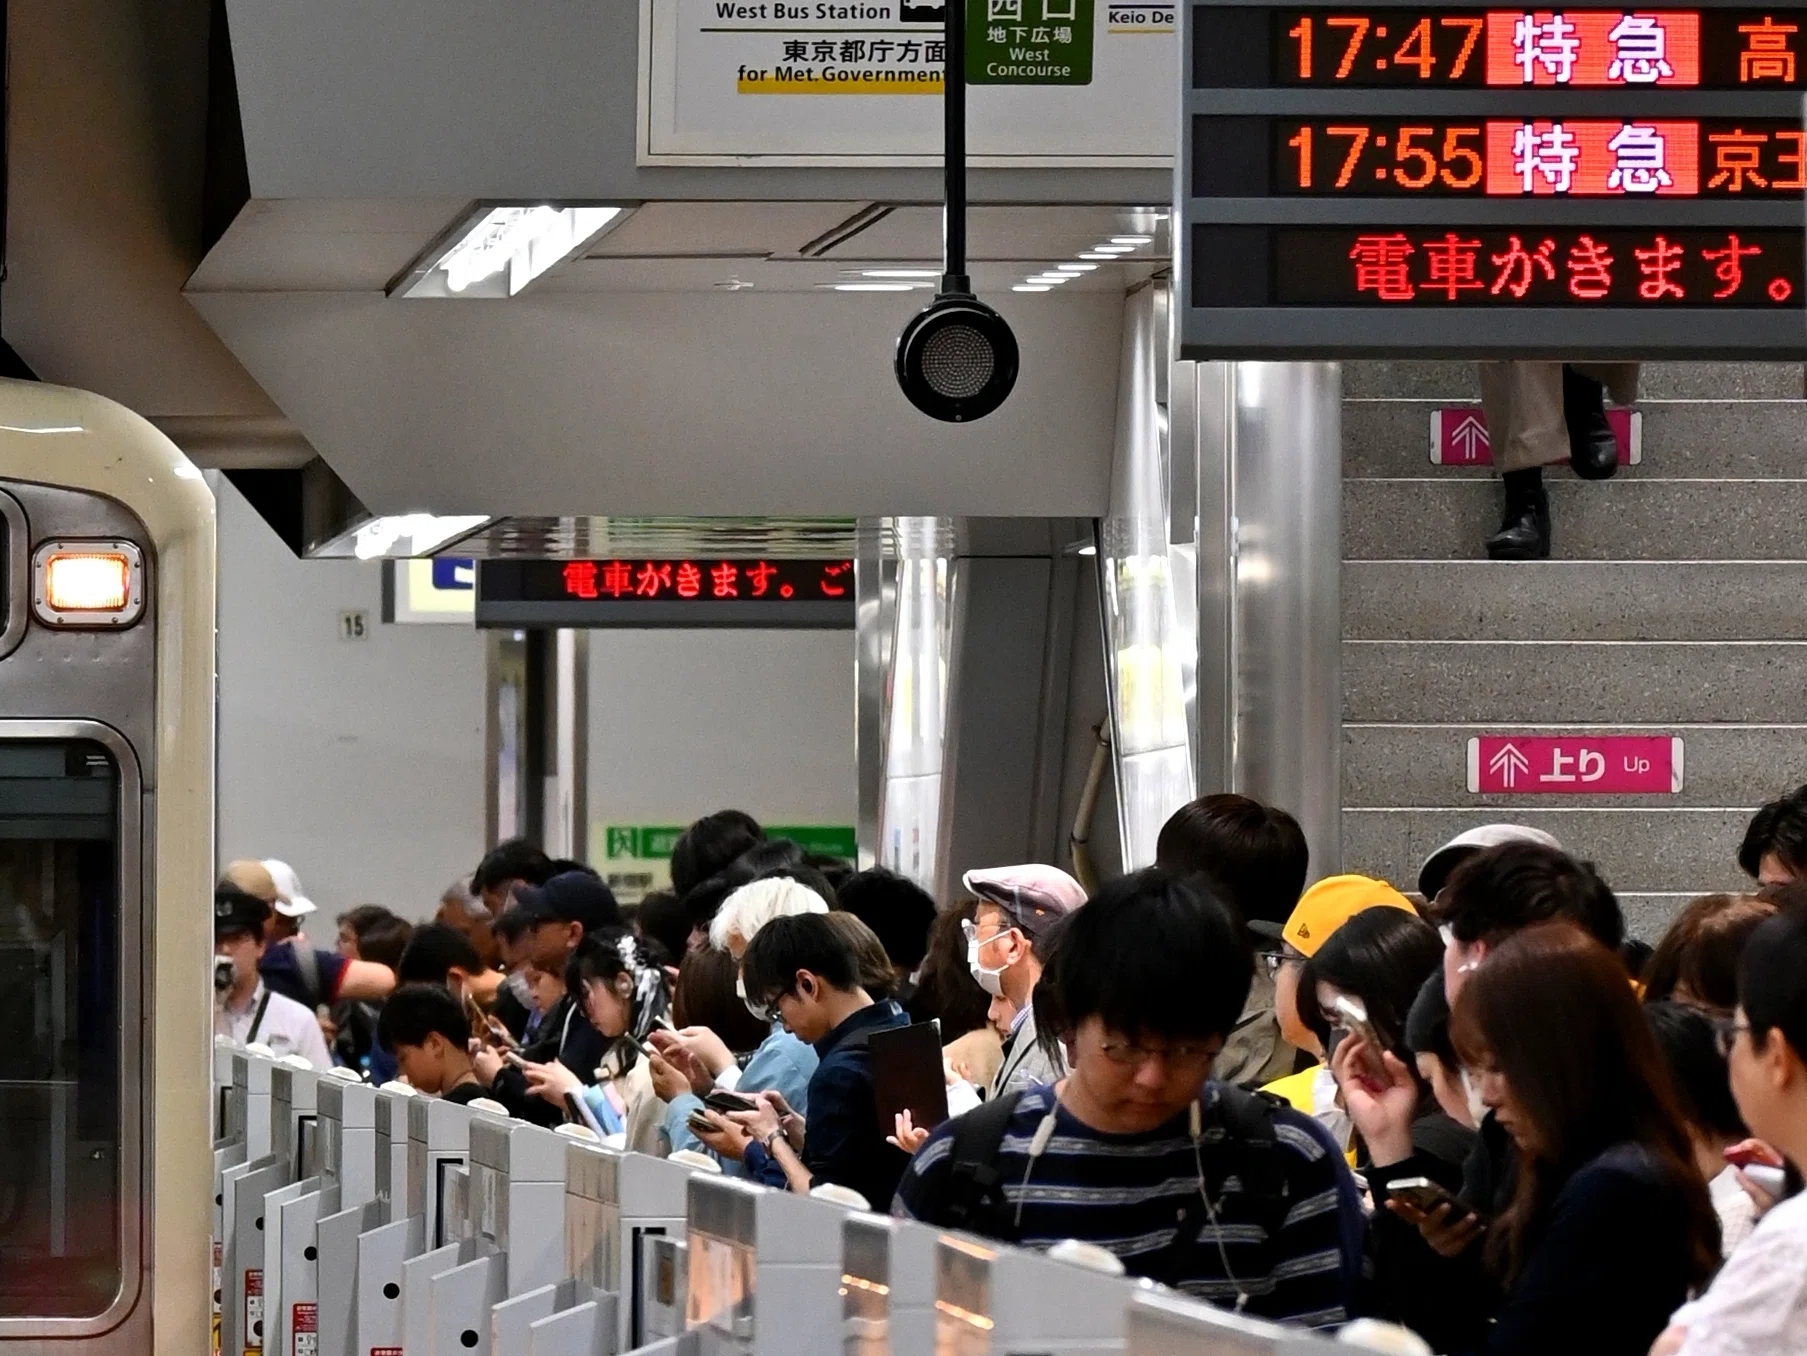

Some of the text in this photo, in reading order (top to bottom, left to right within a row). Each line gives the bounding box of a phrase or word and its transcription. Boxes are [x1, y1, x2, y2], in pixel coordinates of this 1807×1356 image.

[716, 3, 891, 19] West Bus Station
[1108, 11, 1146, 24] Keio
[987, 27, 1072, 43] 地下広場
[782, 40, 946, 63] 東京都庁方面
[1009, 48, 1049, 61] West
[1289, 14, 1798, 83] 17:47 特急 高
[738, 65, 767, 82] for
[987, 62, 1071, 76] Concourse
[1289, 127, 1482, 188] 17:55
[1513, 123, 1673, 191] 特急
[1349, 233, 1791, 300] 電車がきます。
[345, 614, 364, 637] 15
[1539, 747, 1651, 783] 上り Up
